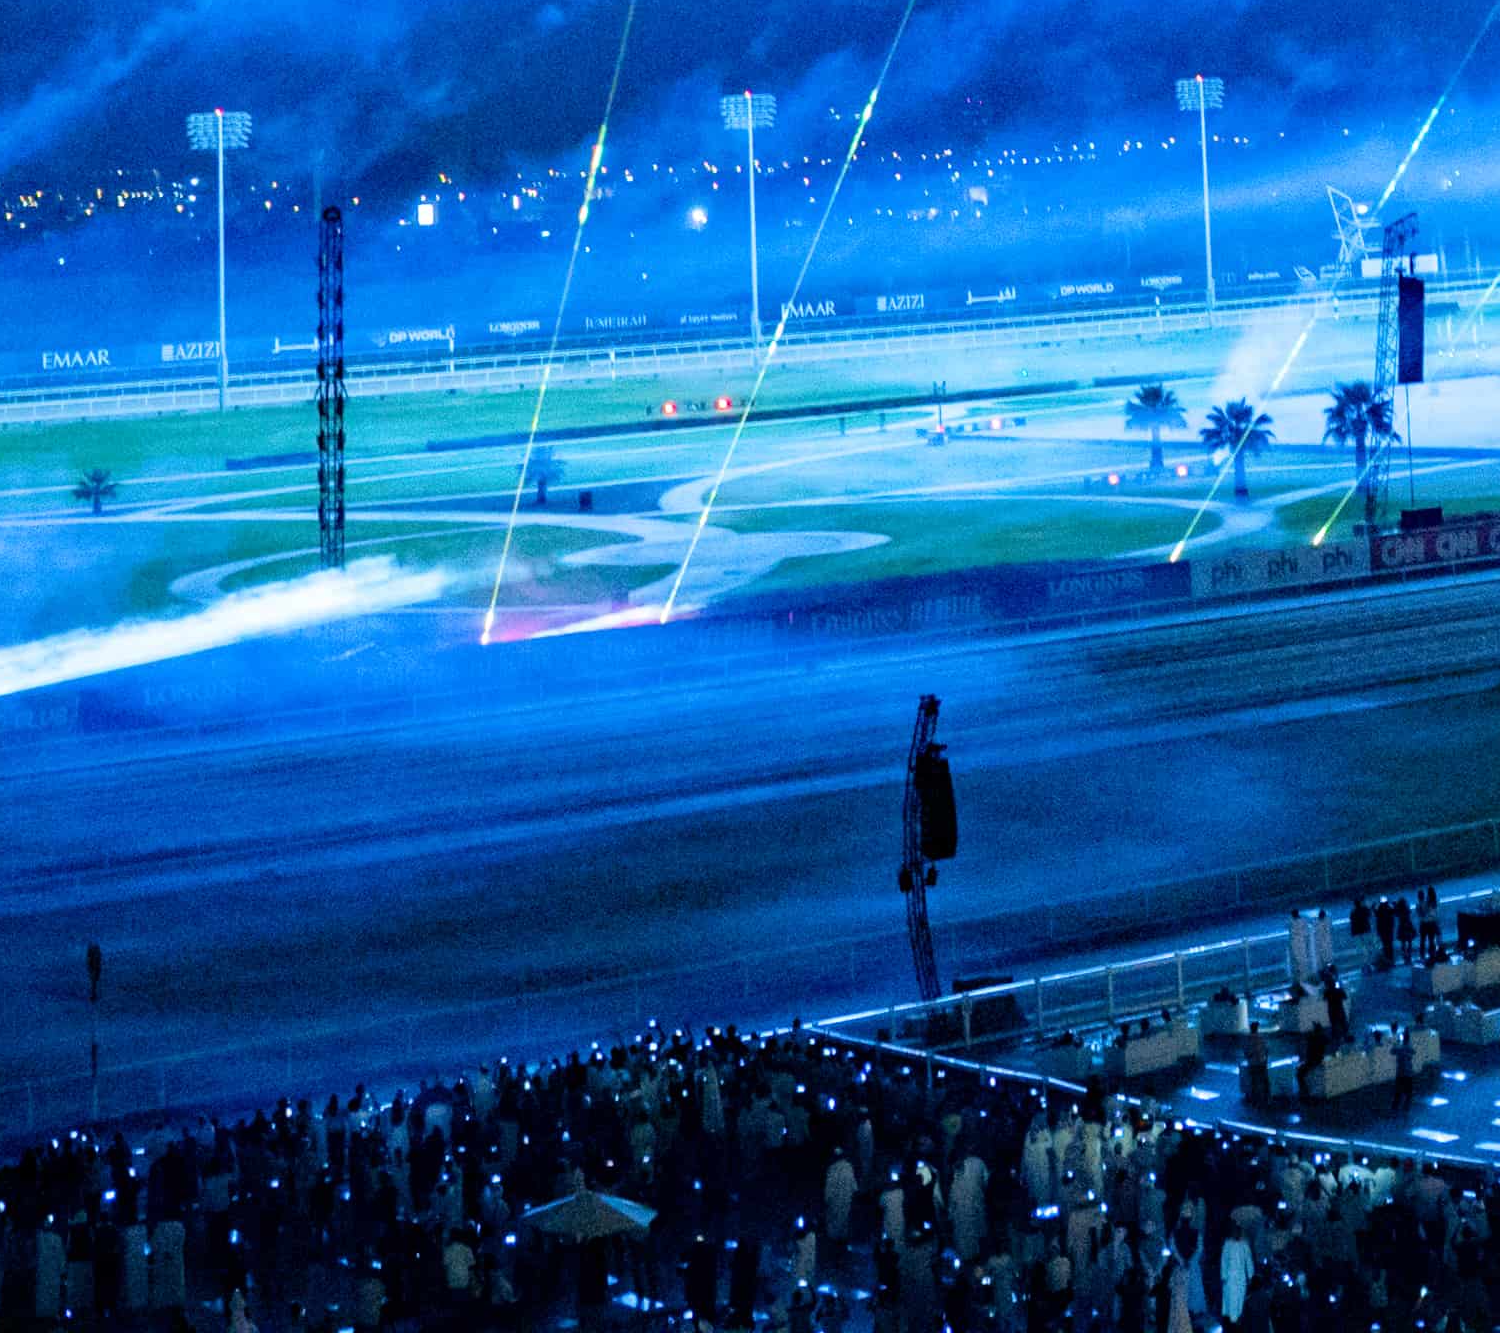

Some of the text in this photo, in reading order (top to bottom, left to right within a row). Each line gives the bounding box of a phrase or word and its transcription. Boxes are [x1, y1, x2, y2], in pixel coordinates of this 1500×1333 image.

[1060, 282, 1115, 297] DP WORLD
[888, 294, 925, 311] AZIZI
[389, 332, 407, 344] DP
[41, 348, 111, 370] EMAAR
[1381, 535, 1424, 566] CNN
[1436, 530, 1479, 558] CNN
[1211, 545, 1353, 588] phi phi phi
